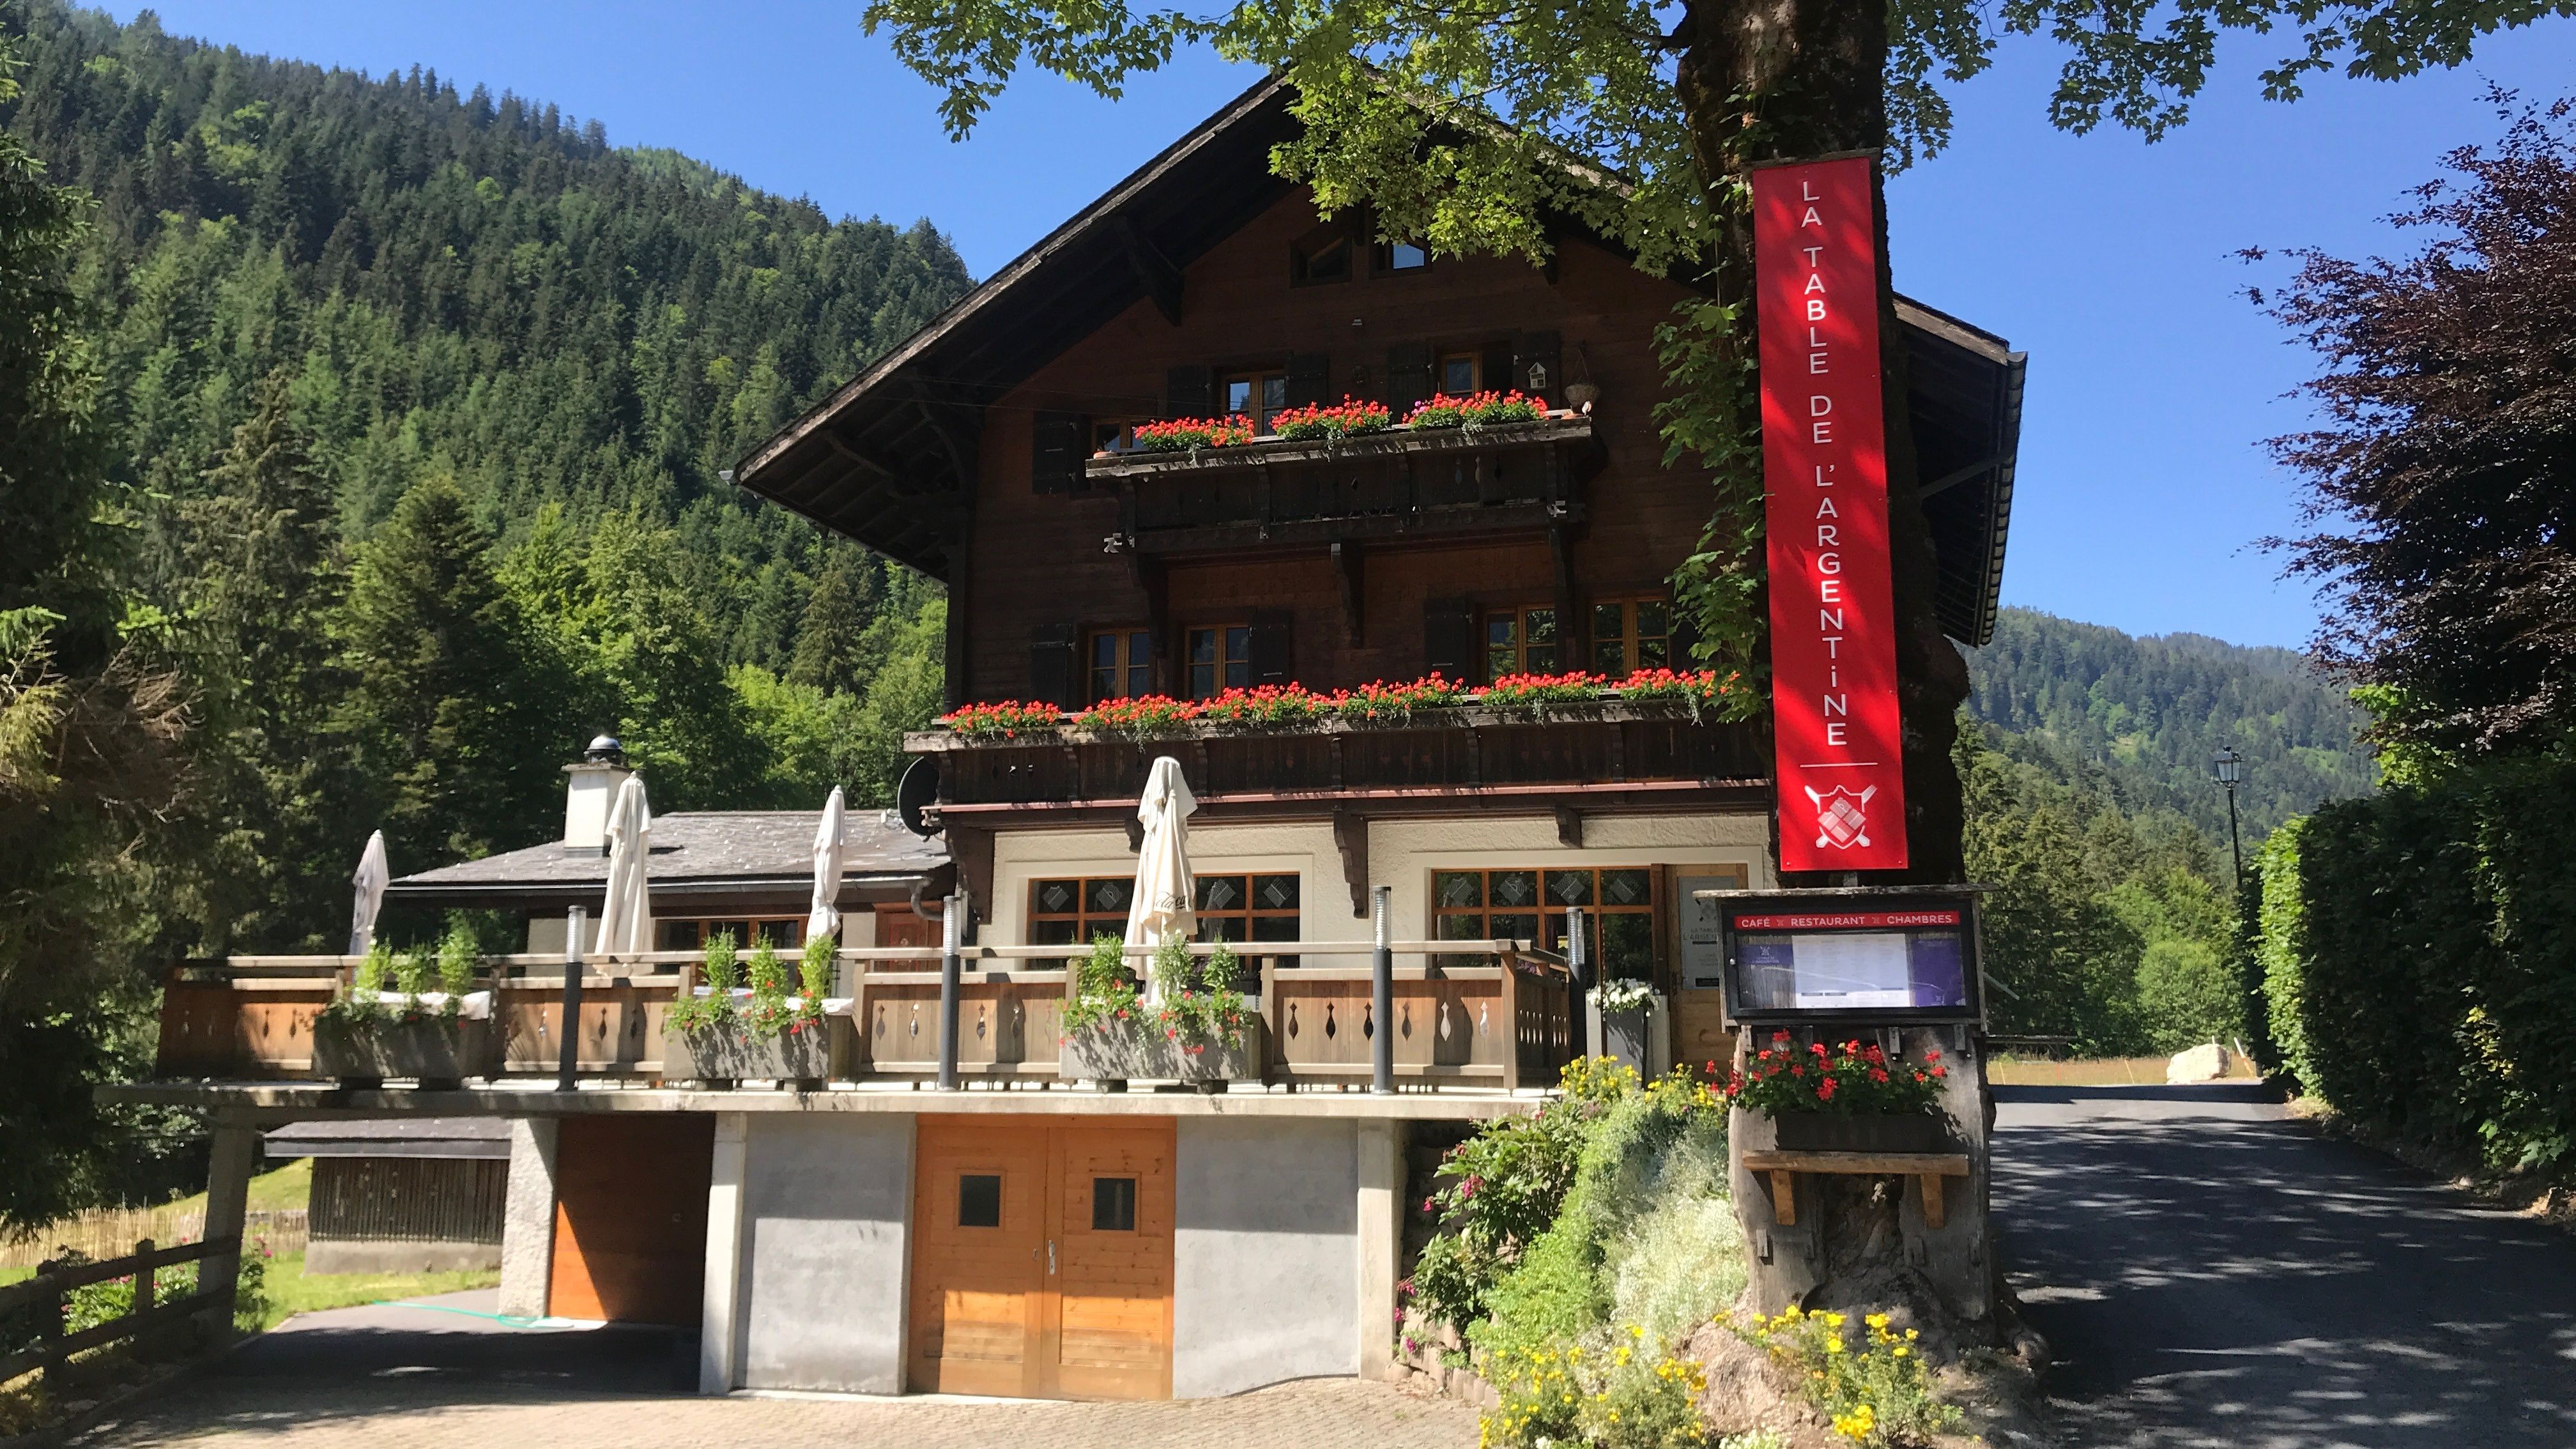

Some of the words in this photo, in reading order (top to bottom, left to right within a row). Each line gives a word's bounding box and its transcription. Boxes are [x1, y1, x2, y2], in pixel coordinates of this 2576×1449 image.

[1801, 181, 1823, 227] LA
[1803, 246, 1828, 374] TABLE
[1810, 395, 1832, 444] DE
[1741, 917, 1770, 928] CAFÉ
[1791, 916, 1865, 926] RESTAURANT
[1887, 914, 1952, 924] CHAMBRES
